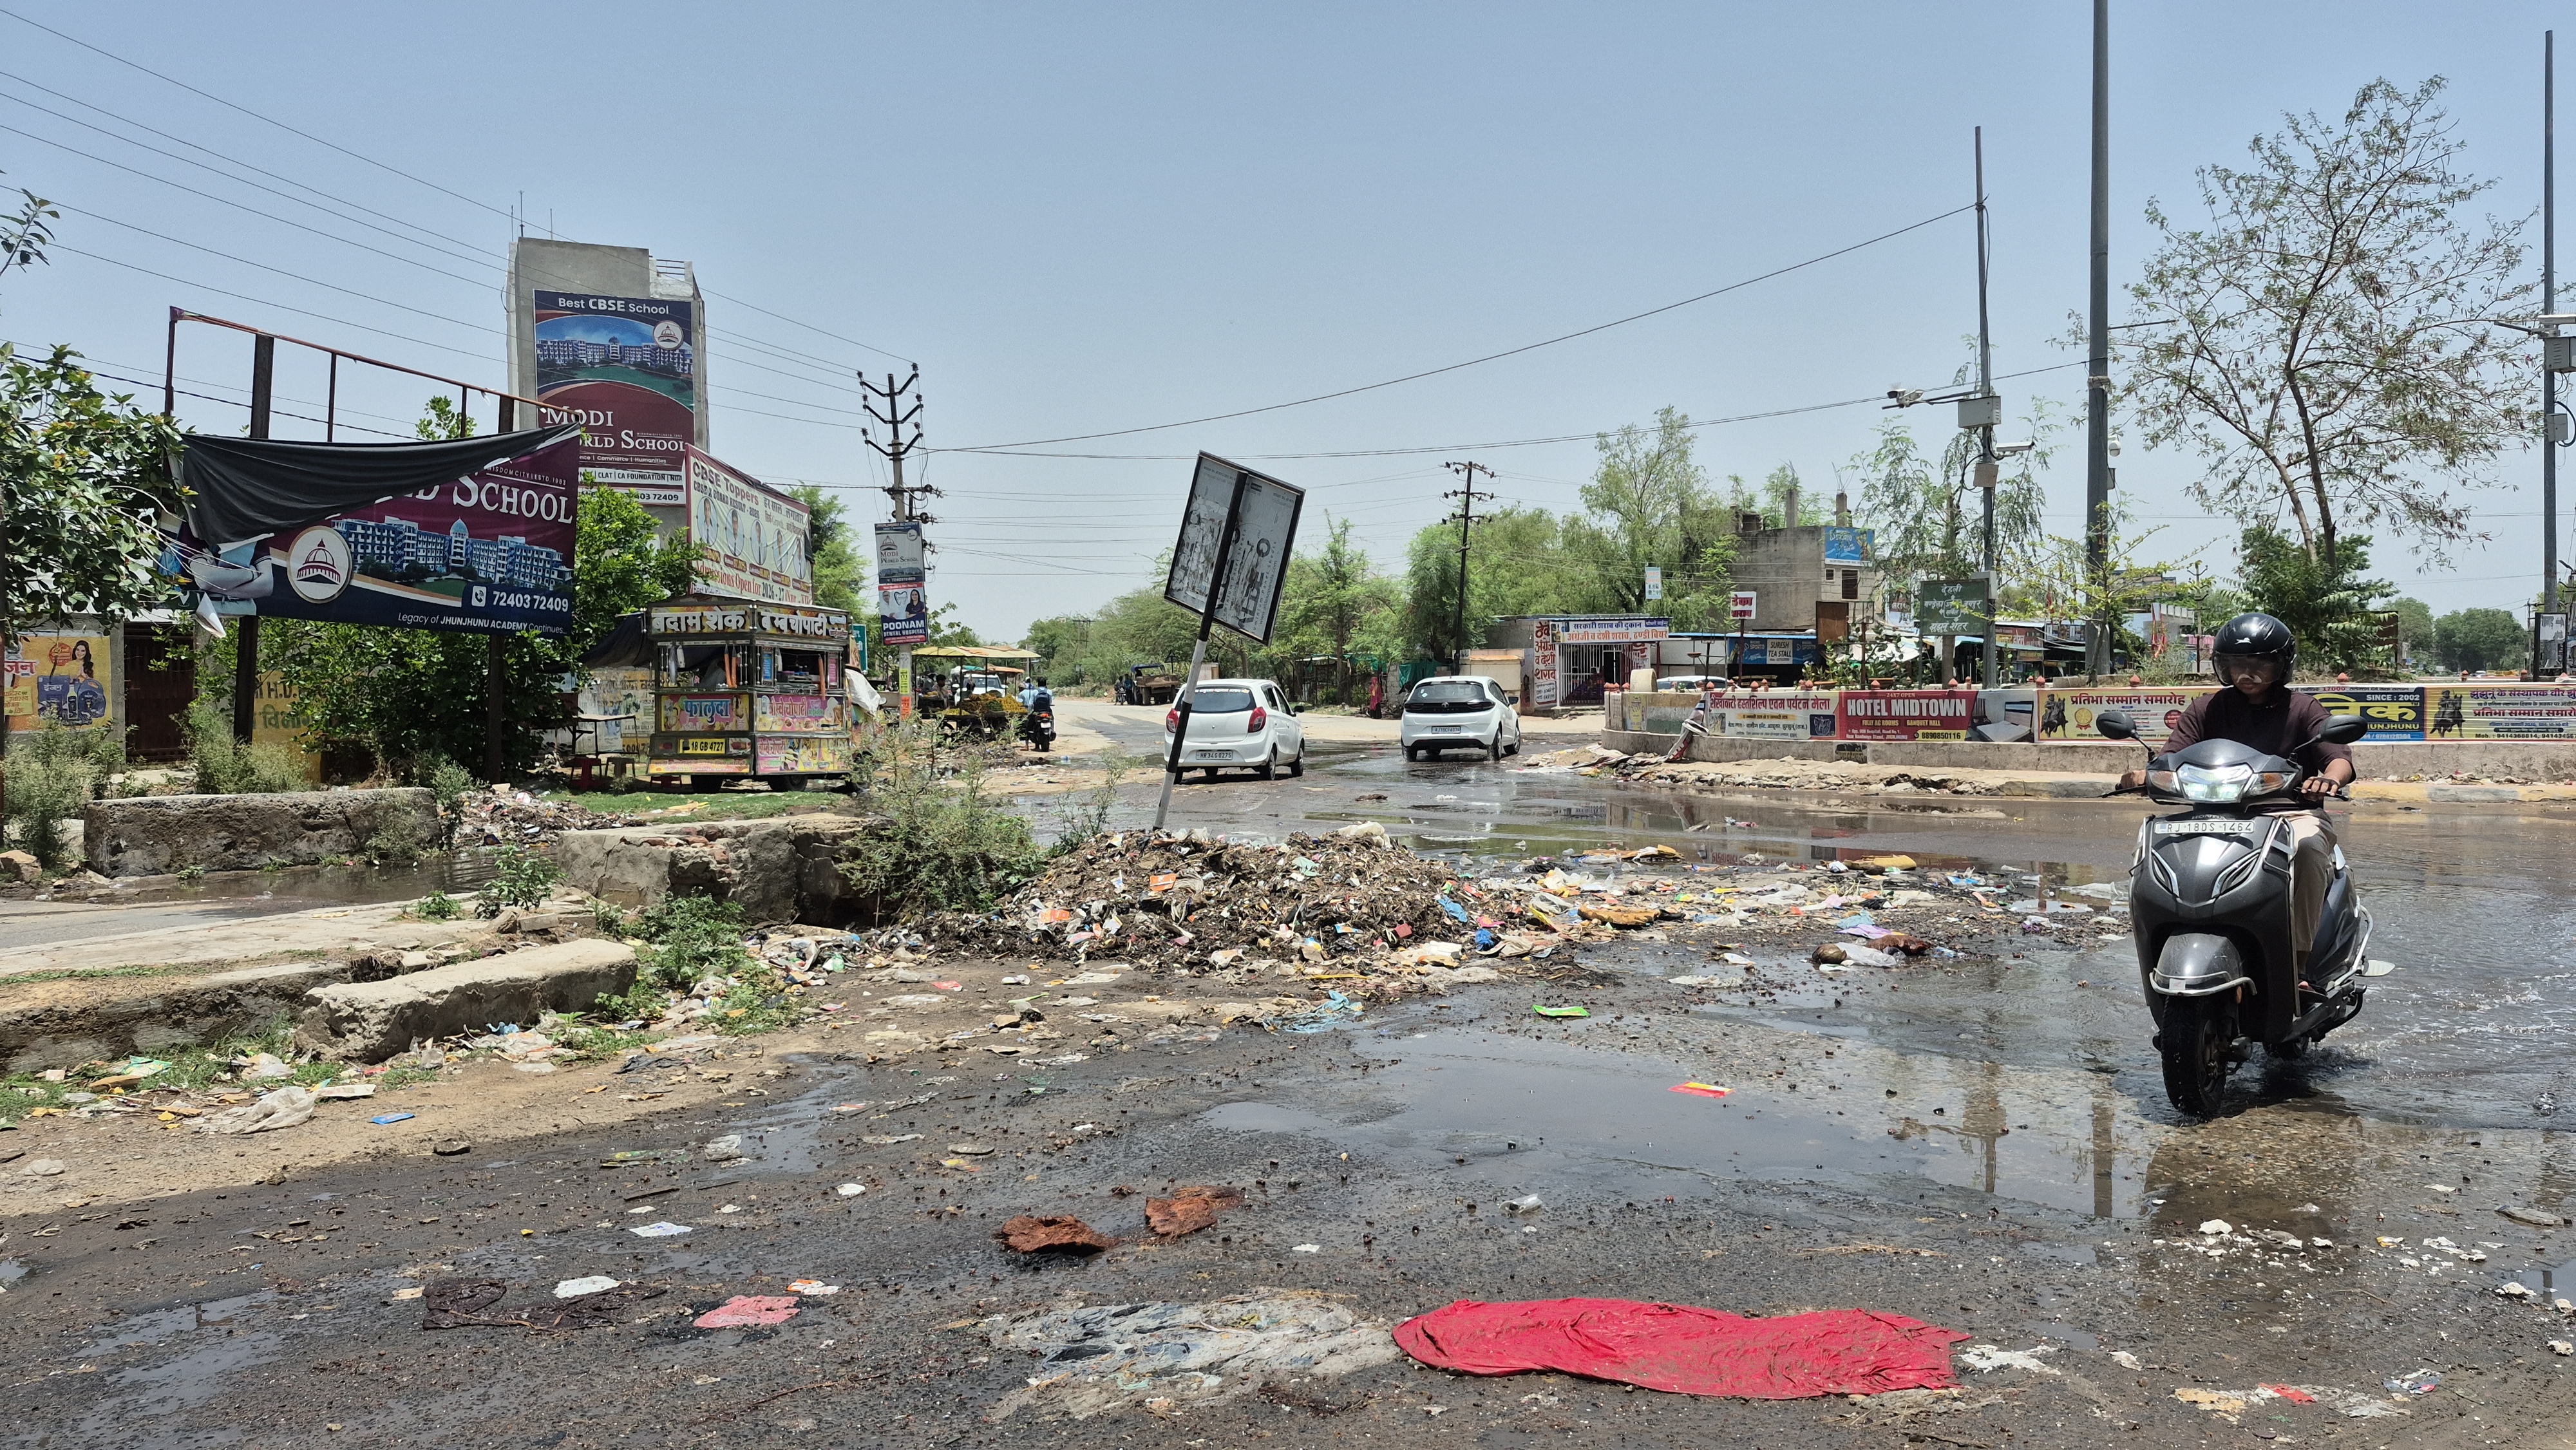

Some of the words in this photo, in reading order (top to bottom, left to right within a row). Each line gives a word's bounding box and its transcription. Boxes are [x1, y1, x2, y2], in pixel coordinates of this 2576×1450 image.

[558, 298, 585, 308] Best
[589, 299, 625, 312] CBSE
[629, 304, 669, 315] School
[545, 406, 614, 426] MODI
[621, 430, 685, 451] SCHOOL
[693, 462, 721, 488] CBSE
[723, 476, 759, 505] Toppers
[453, 475, 573, 523] SCHOOL
[694, 480, 708, 495] CBSE
[714, 490, 729, 505] BOARD
[730, 497, 746, 513] RESULT
[735, 574, 752, 594] Open
[753, 578, 761, 596] for
[493, 591, 530, 608] 72403
[533, 595, 569, 612] 72409
[398, 612, 429, 625] Legacy
[430, 615, 439, 623] of
[440, 616, 489, 628] JHUNJHUNU
[491, 621, 527, 630] ACADEMY
[652, 612, 701, 632] बदाम
[704, 605, 745, 630] शेक
[883, 620, 925, 630] POONAM
[1624, 622, 1642, 630] दुकान
[1567, 630, 1589, 641] अंग्रेजी
[5, 661, 36, 673] जन
[2070, 693, 2103, 705] प्रतिभा
[2106, 695, 2141, 705] सम्मान
[2144, 692, 2185, 706] समारोह
[2508, 689, 2548, 697] संस्थापक
[2551, 688, 2564, 696] वीर
[1787, 695, 1809, 710] पर्यटन
[1811, 695, 1830, 710] मेला
[1847, 699, 1888, 716] HOTEL
[1891, 699, 1966, 717] MIDTOWN
[684, 699, 731, 724] फालुदा
[2473, 707, 2505, 716] प्रतिभा
[2545, 707, 2576, 716] समारो
[691, 742, 698, 751] 18
[699, 742, 708, 751] GB
[710, 742, 724, 751] 4727
[2167, 824, 2181, 833] RJ
[2188, 823, 2215, 831] 18DS
[2222, 822, 2251, 832] 1464
